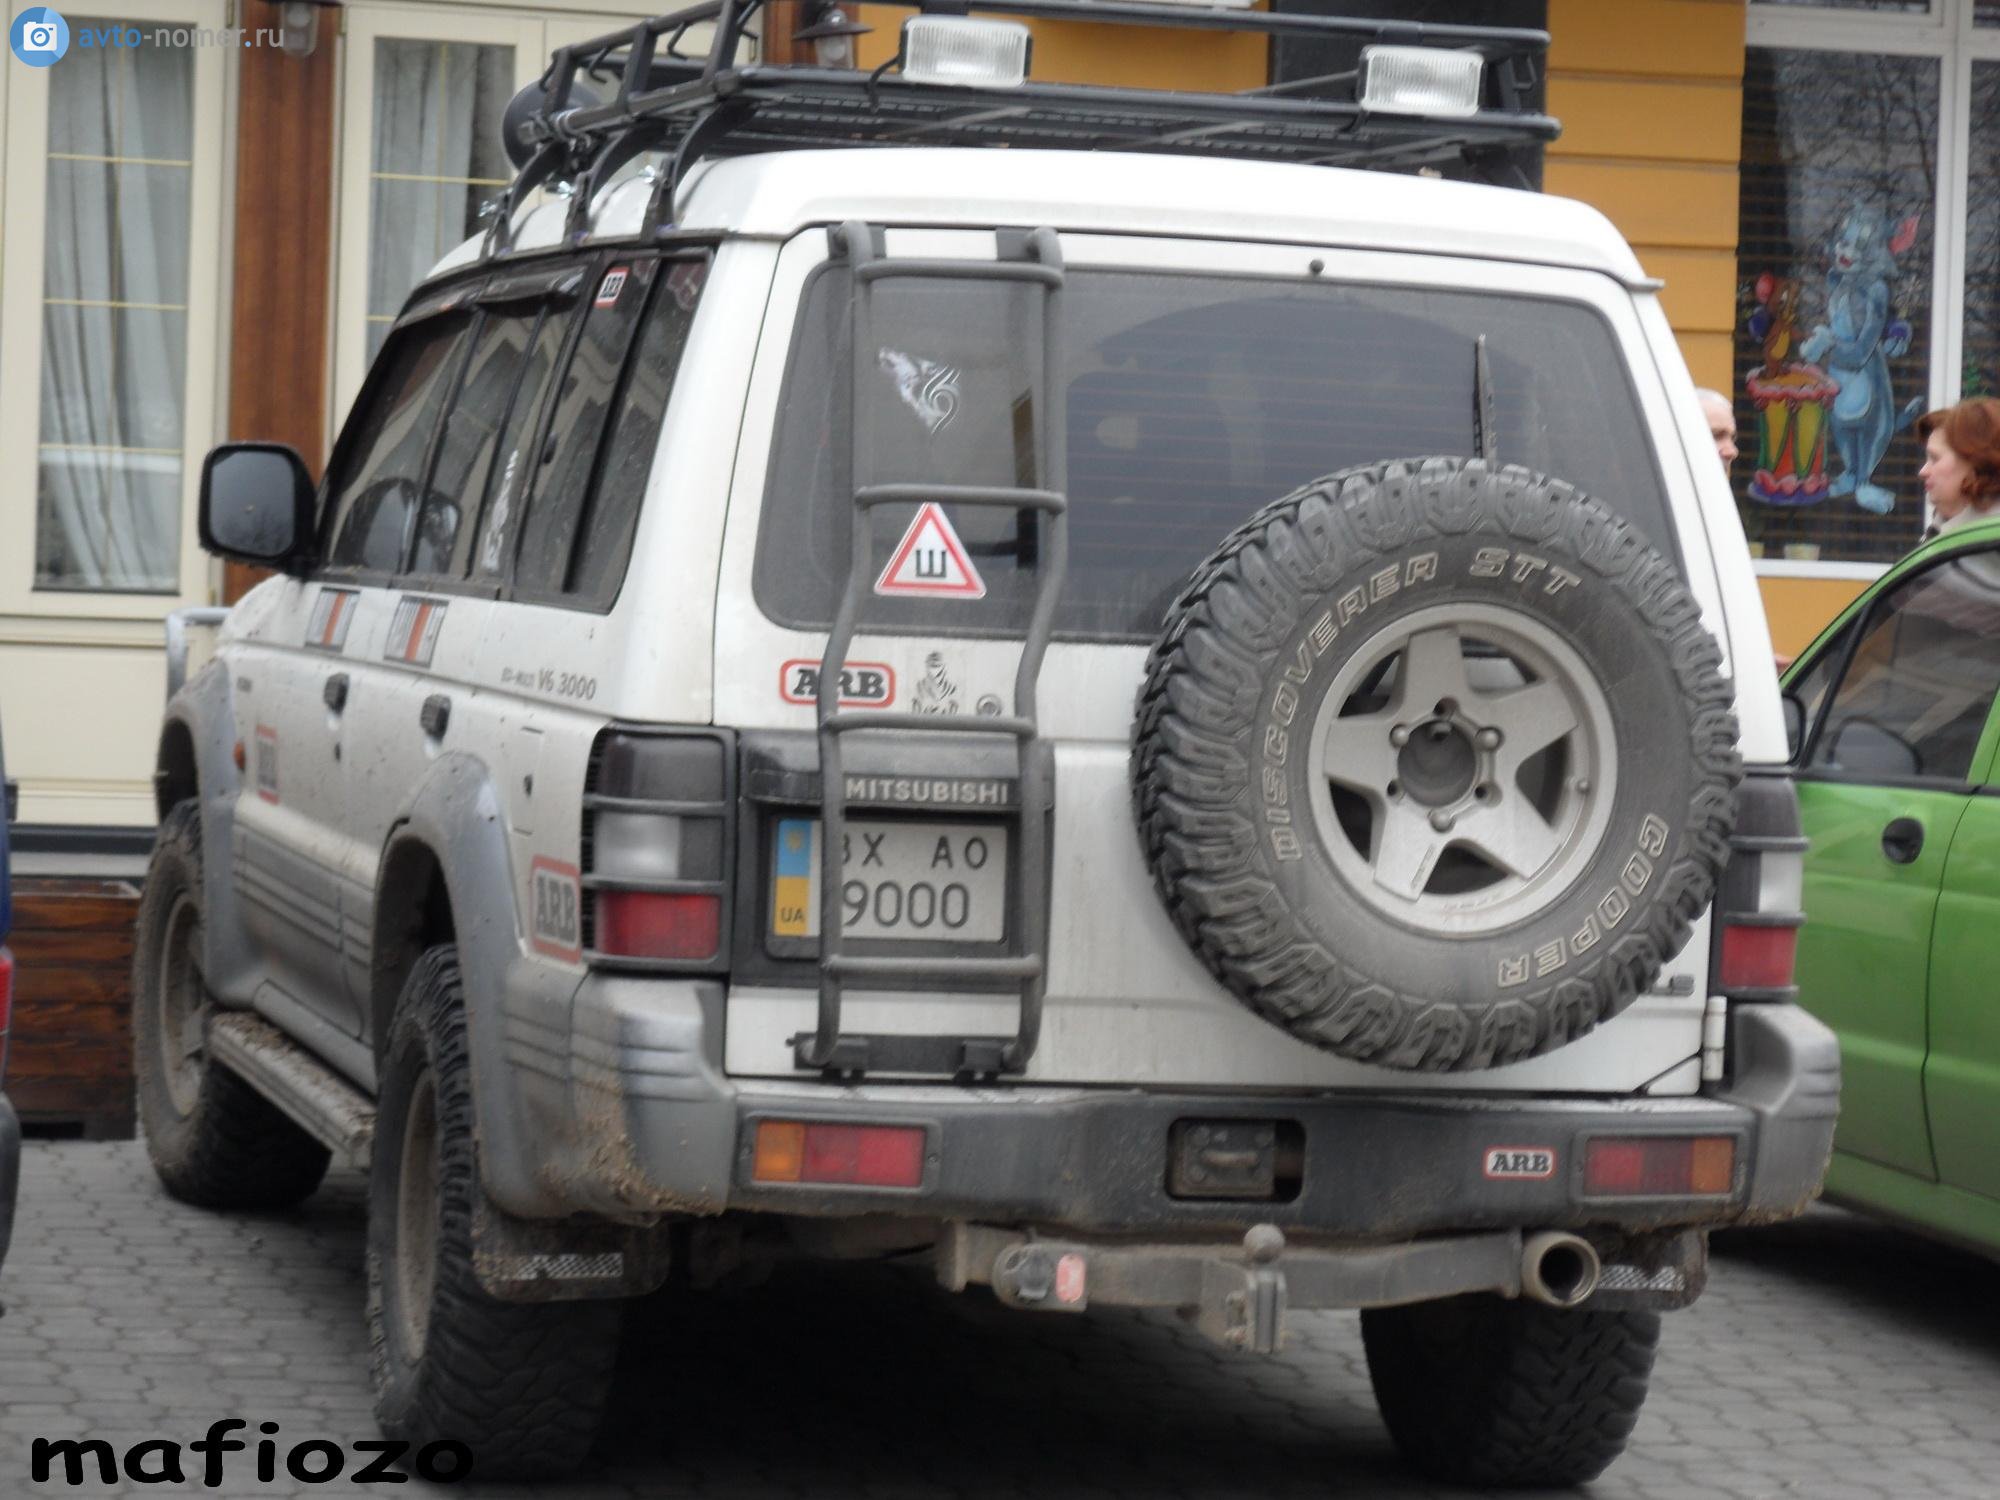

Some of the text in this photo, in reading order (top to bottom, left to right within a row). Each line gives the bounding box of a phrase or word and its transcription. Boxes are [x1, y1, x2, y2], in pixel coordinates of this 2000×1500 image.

[916, 549, 946, 578] Ш
[557, 672, 596, 701] 3000
[1262, 546, 1581, 862] DISCOVERER STT
[845, 778, 1009, 805] MITSUBISHI
[843, 833, 885, 867] X
[842, 879, 970, 929] 9000
[1498, 812, 1669, 988] COOPER
[780, 907, 806, 923] UA
[1491, 1153, 1552, 1172] ARB
